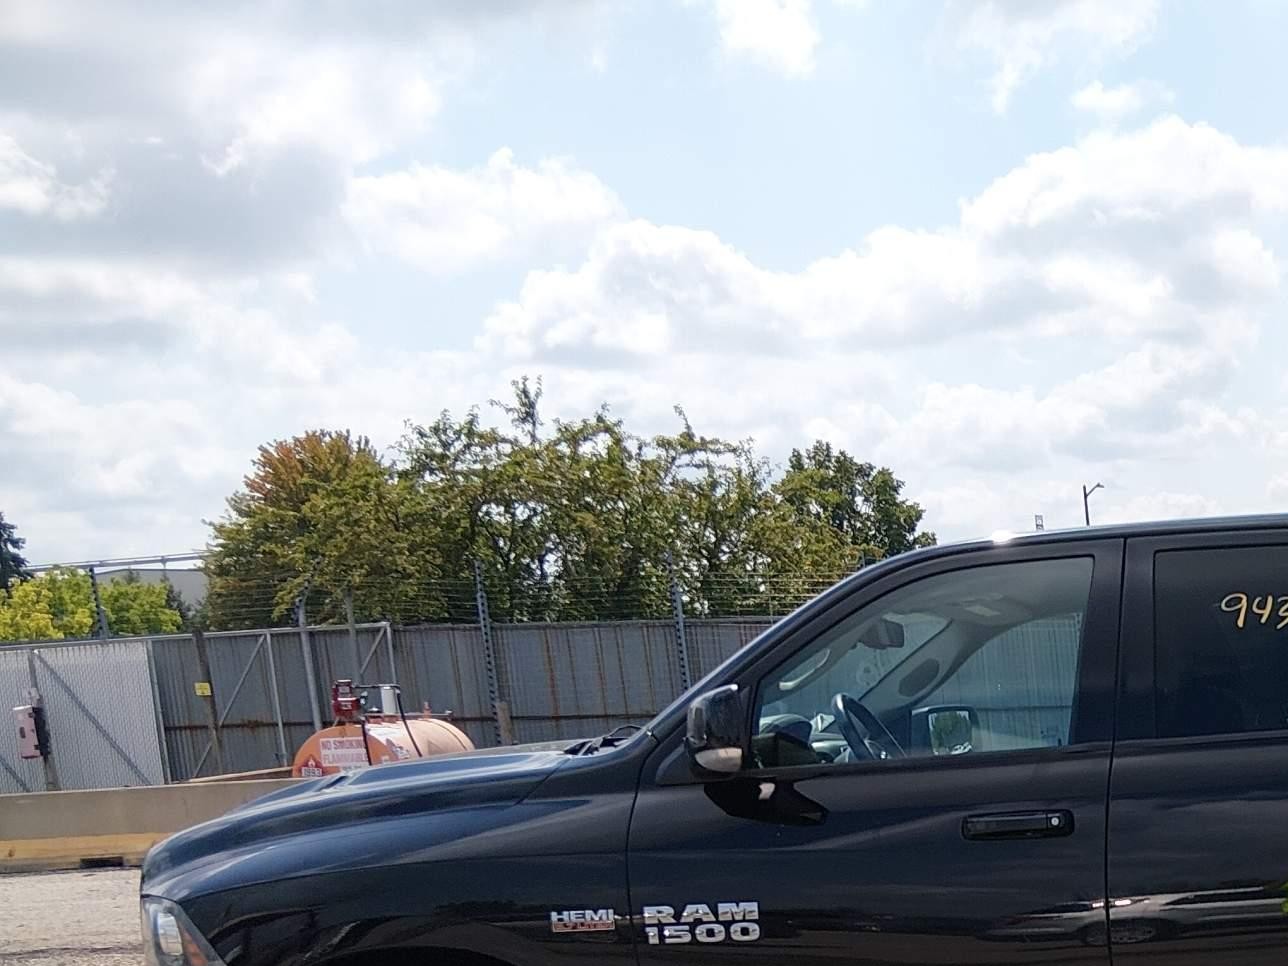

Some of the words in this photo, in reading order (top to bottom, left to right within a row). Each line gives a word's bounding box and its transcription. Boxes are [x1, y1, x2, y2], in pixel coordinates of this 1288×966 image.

[321, 740, 332, 751] NO
[333, 739, 364, 750] SMOKIN
[323, 752, 368, 765] FLAMMABL
[551, 909, 614, 922] HEMI
[643, 902, 759, 924] RAM
[645, 922, 760, 945] 1500
